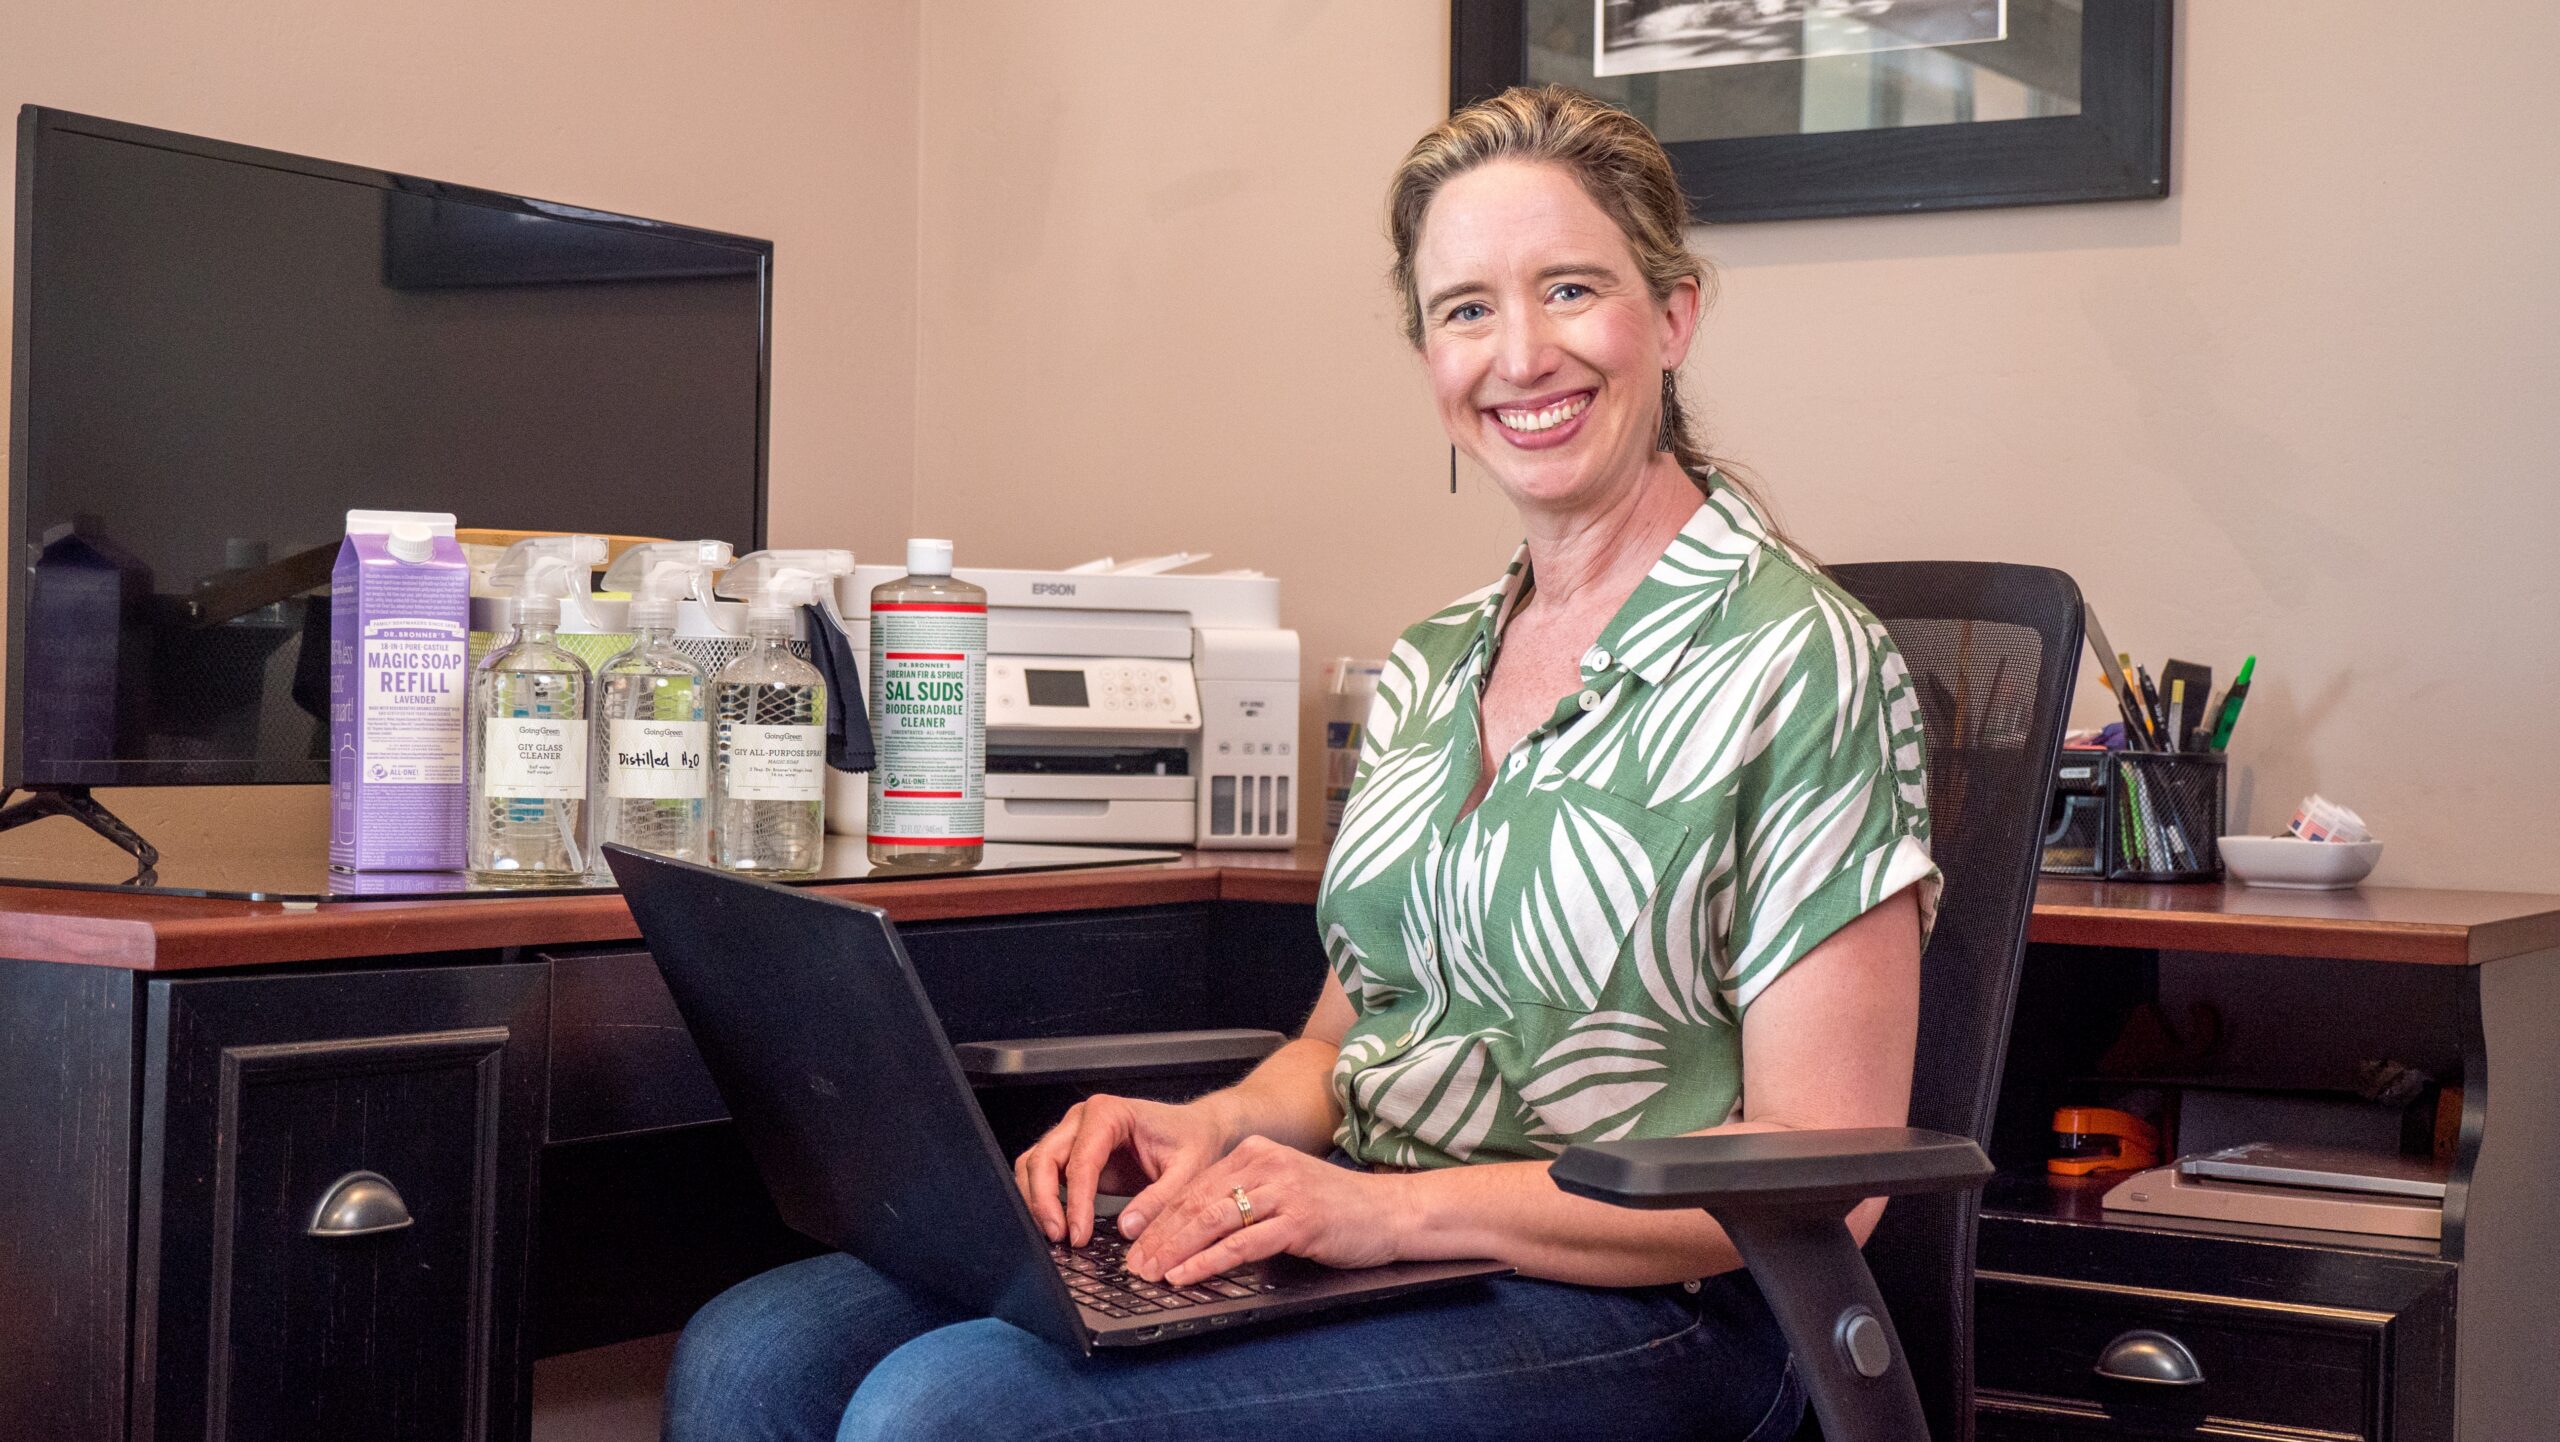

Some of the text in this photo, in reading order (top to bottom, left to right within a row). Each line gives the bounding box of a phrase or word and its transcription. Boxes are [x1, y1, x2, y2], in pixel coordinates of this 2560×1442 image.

[1032, 582, 1076, 597] EPSON
[383, 631, 447, 639] DR. BRONNER'S
[368, 652, 462, 670] MAGIC SOAP
[886, 670, 964, 680] SIBERIAN FIR & SPRUCE
[380, 671, 450, 693] REFILL
[885, 681, 965, 702] SAL SUDS
[394, 695, 437, 705] LAVENDER
[885, 703, 964, 716] BIODEGRADABLE
[901, 716, 947, 728] CLEANER
[517, 743, 564, 752] GIY GLASS
[734, 748, 748, 756] GIY
[749, 749, 806, 757] ALL-PURPOSE
[519, 752, 562, 760] CLEANER
[618, 749, 670, 769] Distilled
[390, 768, 420, 776] ALL-ONE!
[901, 777, 928, 785] ALL-ONE!
